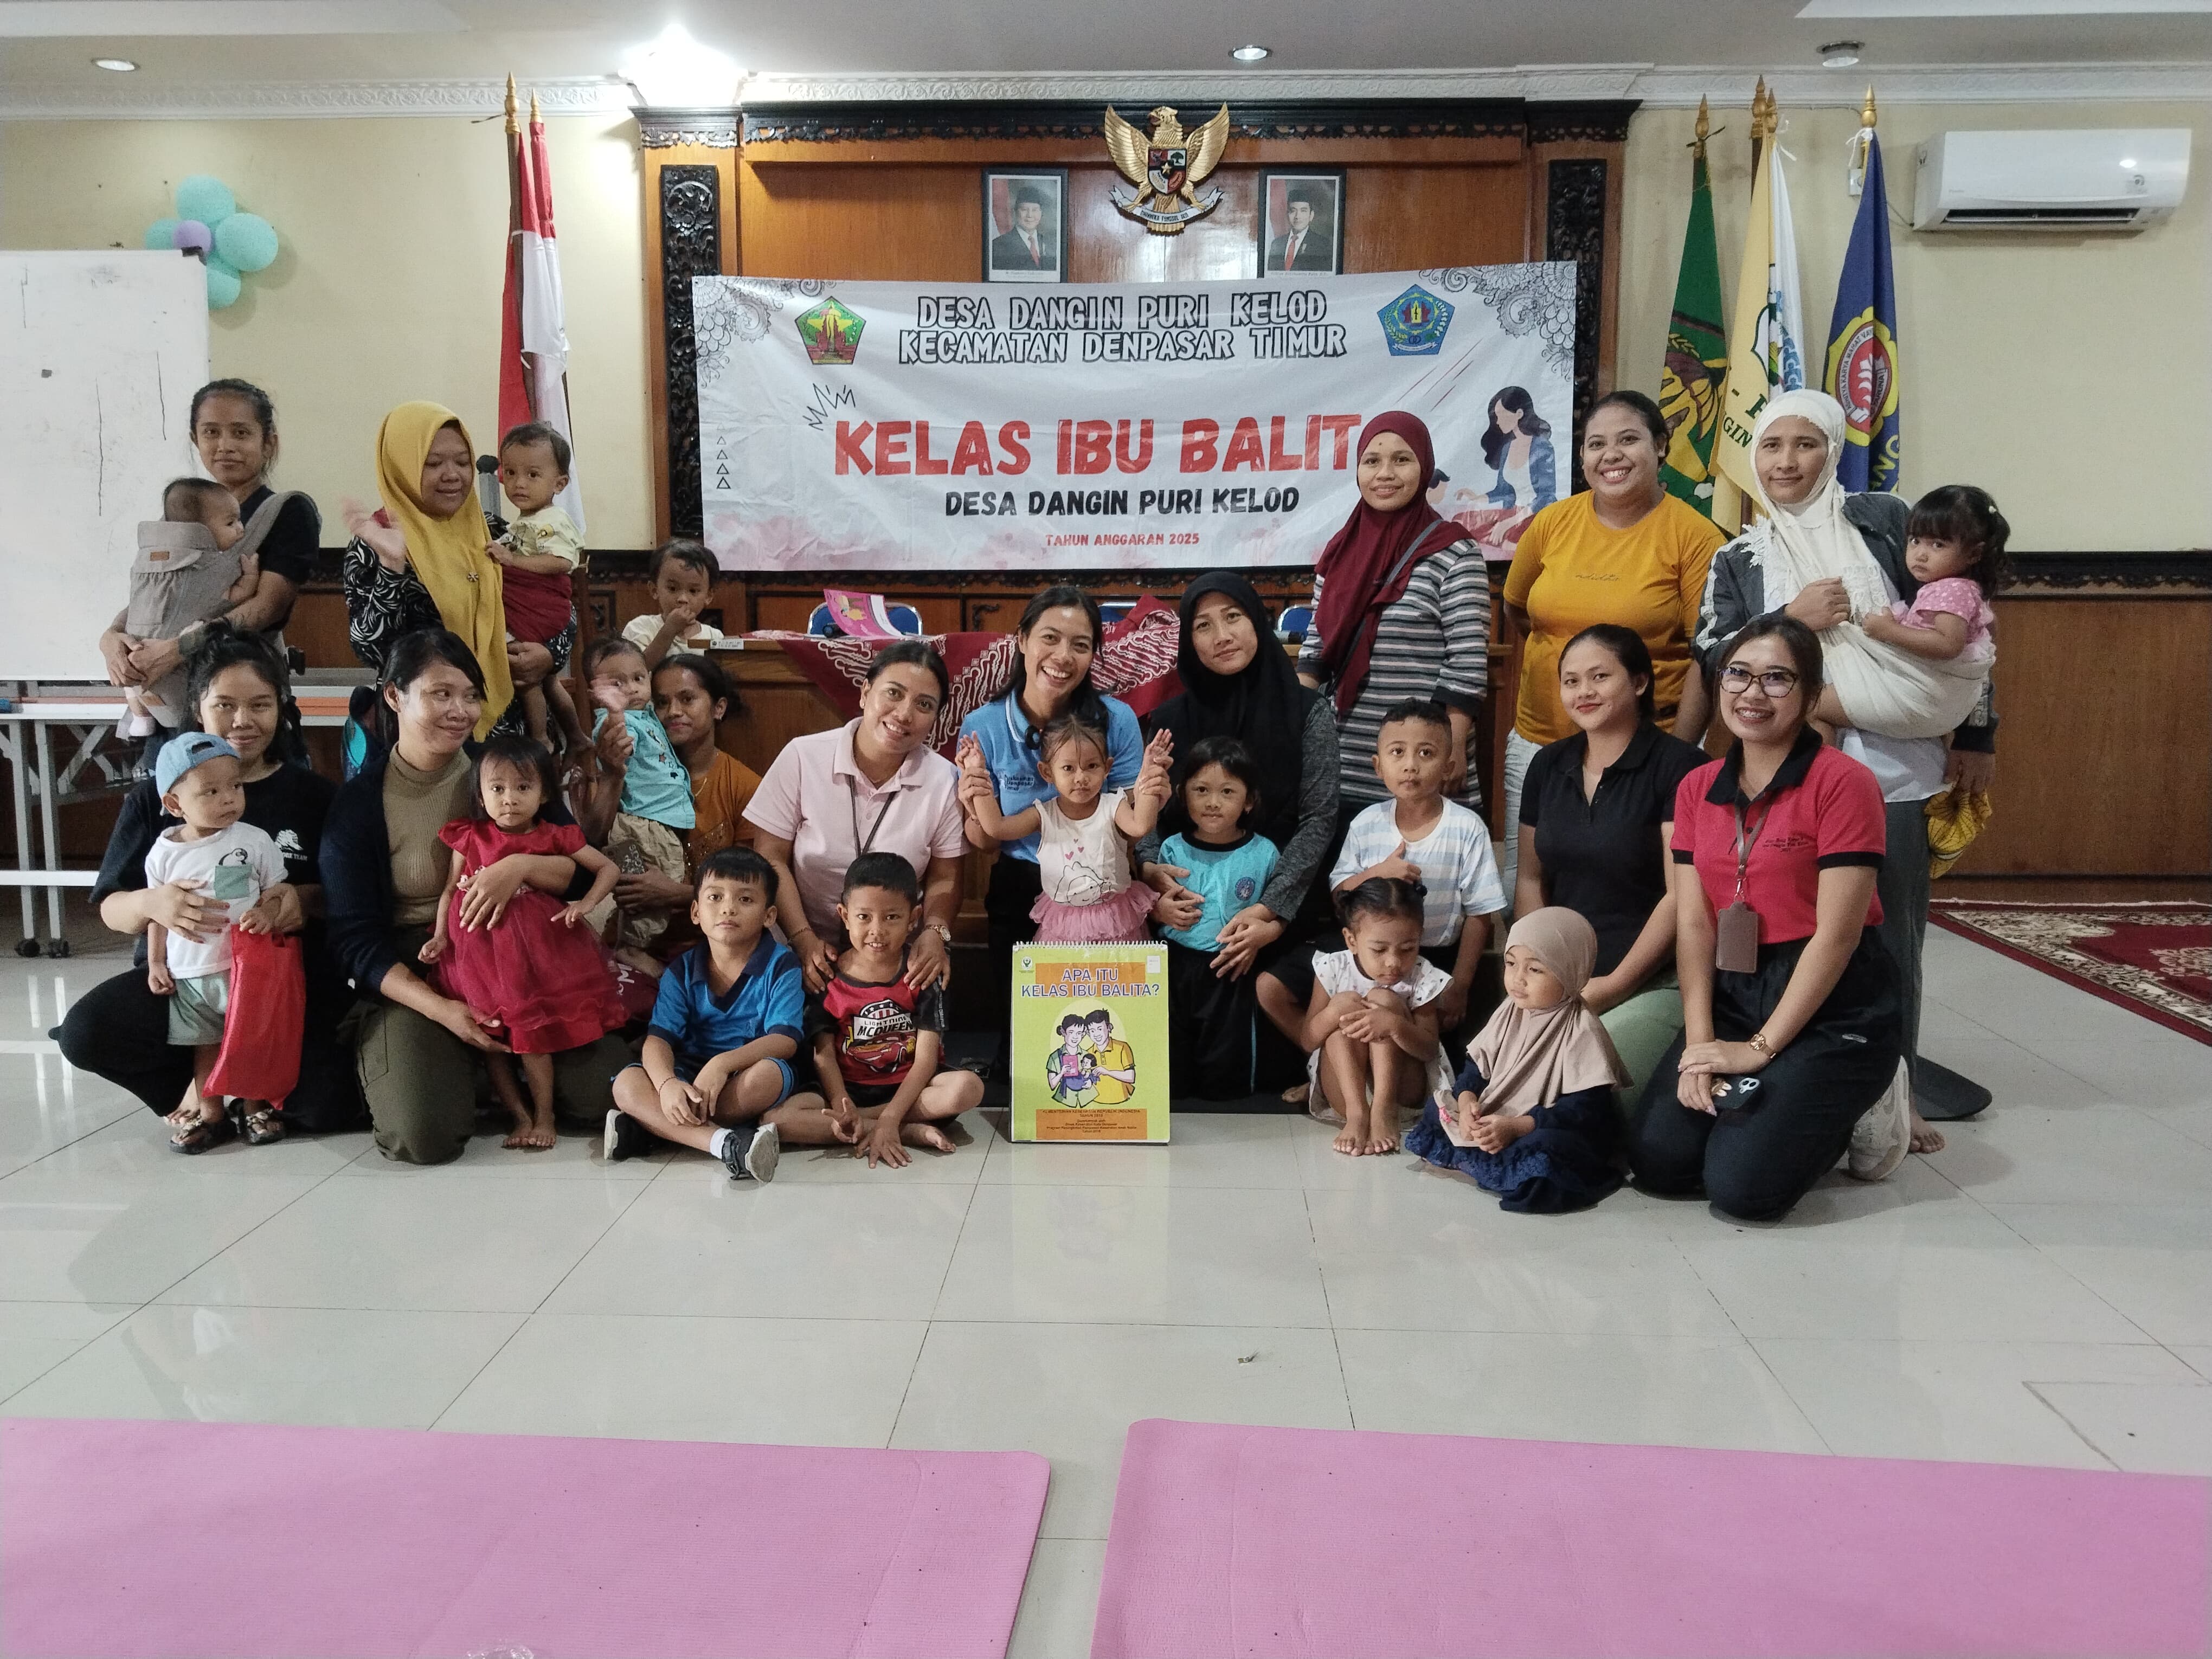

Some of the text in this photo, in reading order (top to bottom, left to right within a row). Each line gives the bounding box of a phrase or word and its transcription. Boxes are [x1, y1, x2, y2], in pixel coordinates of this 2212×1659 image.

[917, 290, 1327, 330] DESA DANGIN PURI KELOD
[899, 324, 1347, 365] KECAMATAN DENPASAR TIMUR
[835, 414, 1362, 475] KELAS IBU BALIT
[1723, 411, 1753, 448] GIN
[946, 487, 1300, 516] DESA DANGIN PURI KELOD
[1046, 533, 1200, 546] TAHUN ANGGARAN 2025
[1021, 983, 1160, 997] KELAS IBU BALITA?
[1062, 968, 1118, 981] APA ITU
